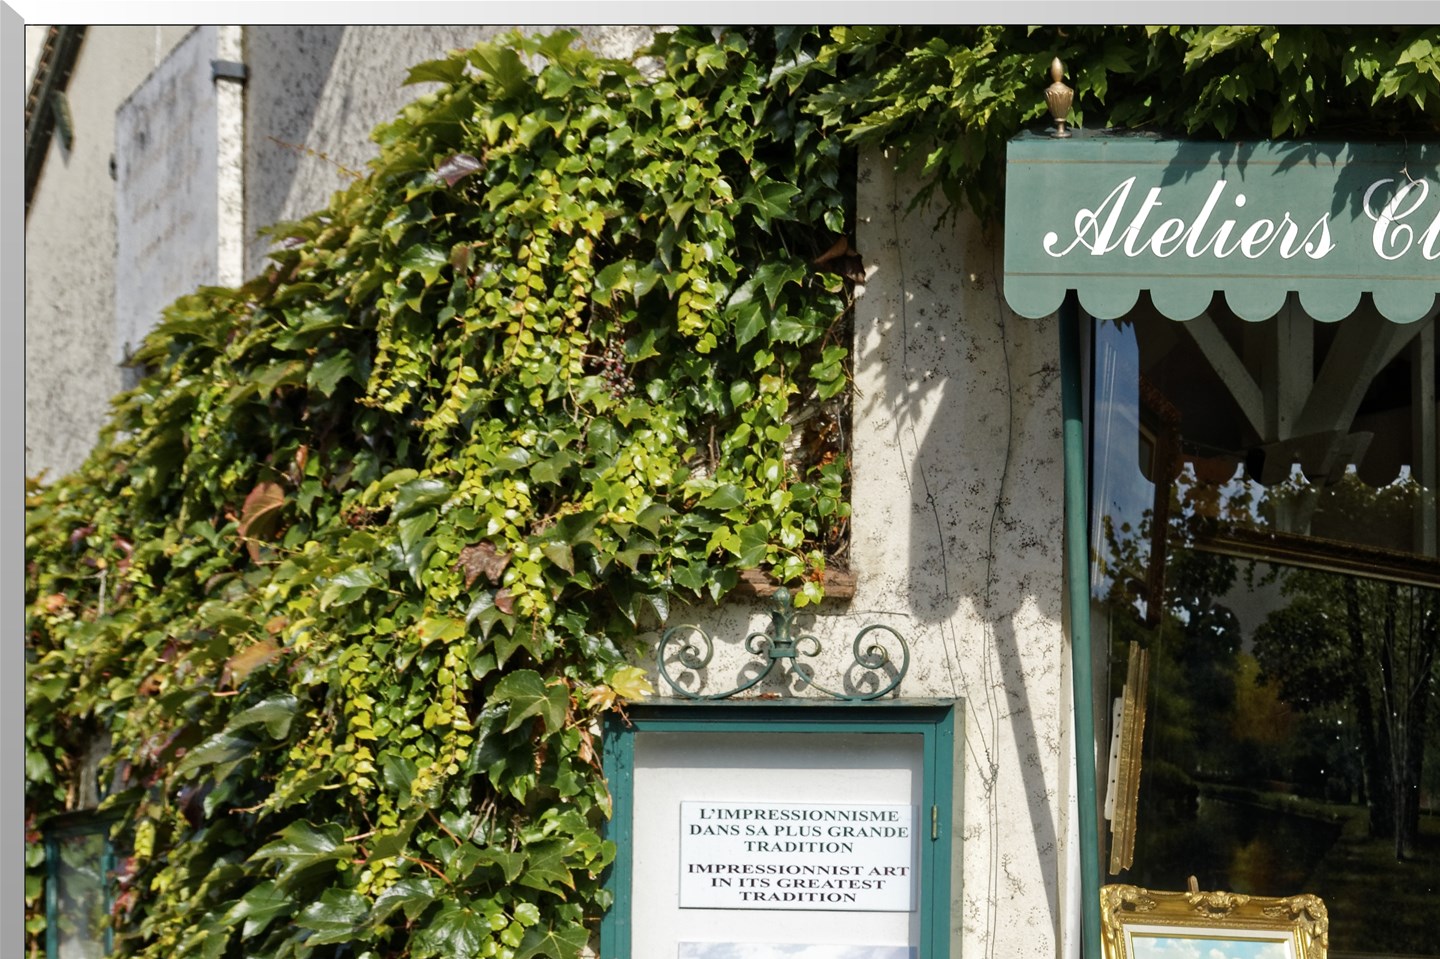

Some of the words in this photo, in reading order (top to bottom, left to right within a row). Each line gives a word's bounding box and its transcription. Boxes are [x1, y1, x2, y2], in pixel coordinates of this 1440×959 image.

[1043, 176, 1335, 261] Ateliers
[690, 824, 740, 836] DANS
[745, 825, 767, 837] SA
[774, 826, 822, 837] PLUS
[828, 826, 909, 838] GRANDE
[744, 841, 853, 853] TRADITION
[688, 864, 864, 875] IMPRESSIONNIST
[869, 866, 909, 876] ART
[711, 877, 731, 887] IN
[739, 878, 770, 888] ITS
[777, 879, 886, 890] GREATEST
[739, 891, 856, 902] TRADITION
